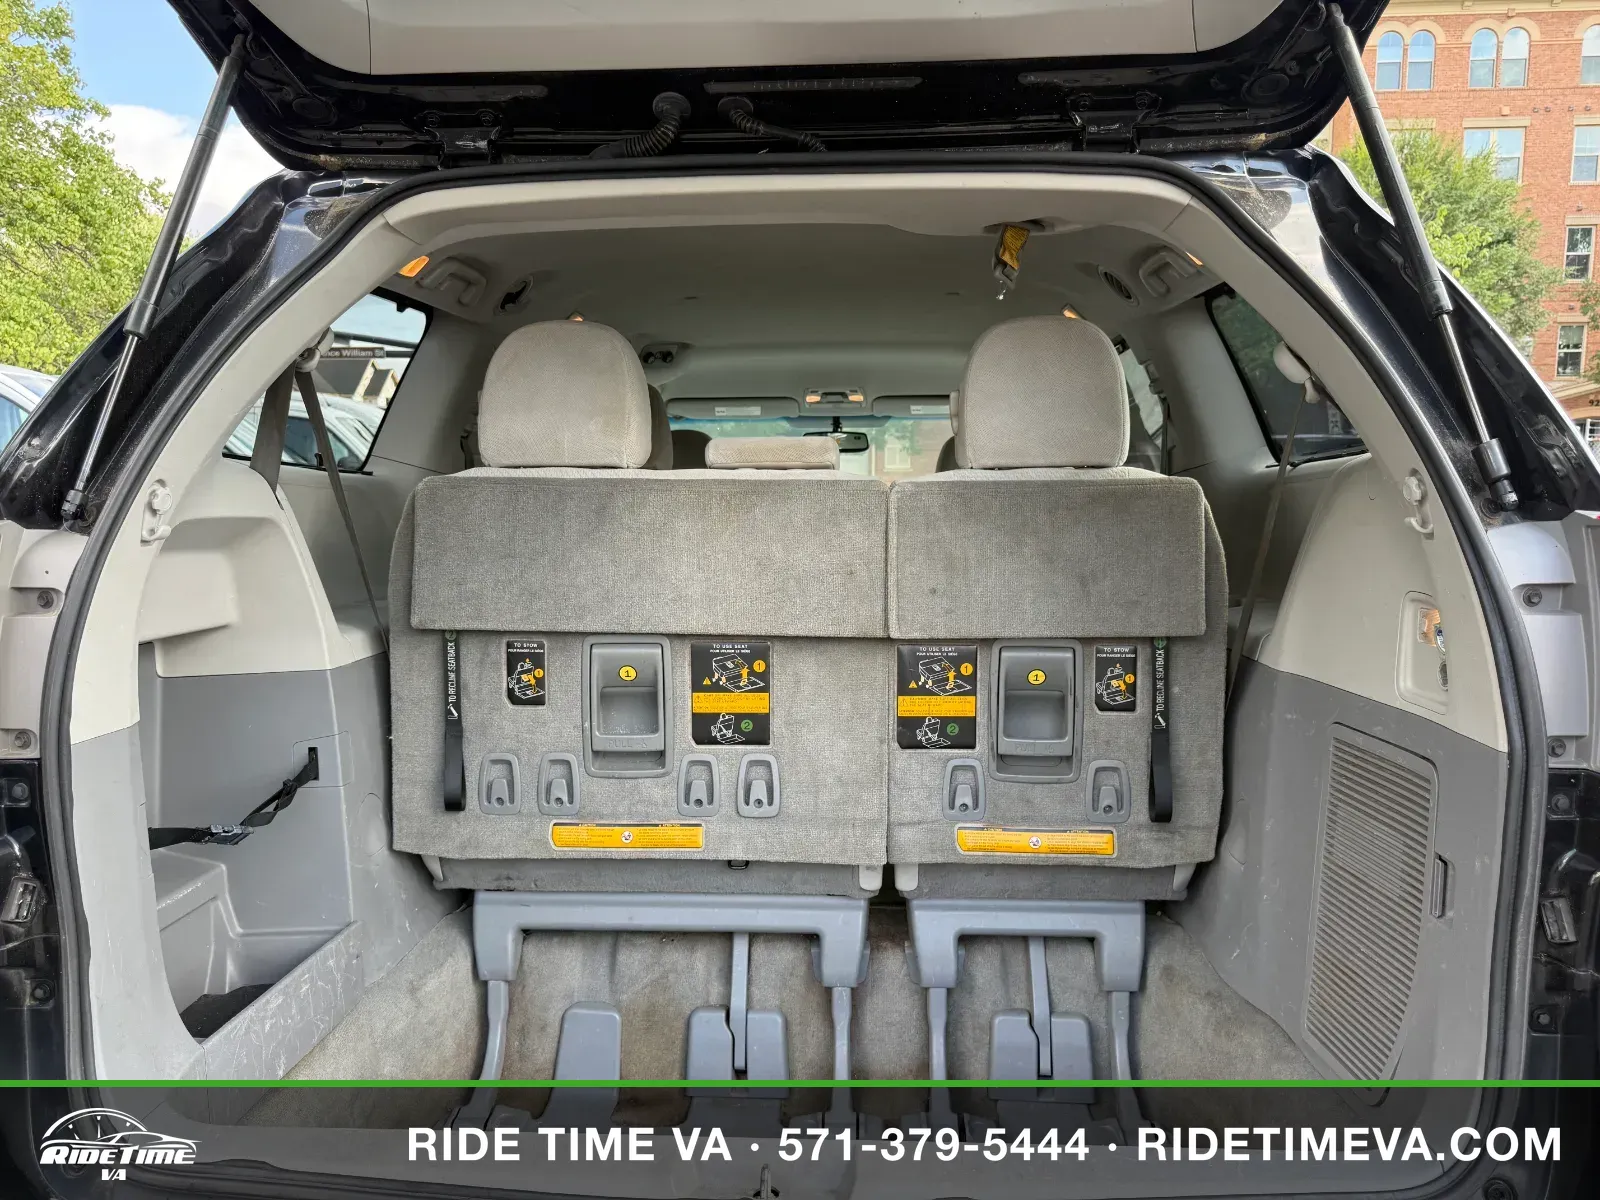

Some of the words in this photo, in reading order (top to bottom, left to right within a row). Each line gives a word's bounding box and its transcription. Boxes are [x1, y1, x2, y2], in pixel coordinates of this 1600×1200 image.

[341, 349, 373, 357] William
[374, 349, 384, 357] St
[447, 642, 457, 671] SEATBACK
[1155, 649, 1165, 679] SEATBACK
[448, 672, 457, 695] RECLINE
[1155, 680, 1165, 703] RECLINE
[448, 695, 457, 703] TO
[1155, 703, 1165, 712] TO
[608, 740, 633, 748] PULL
